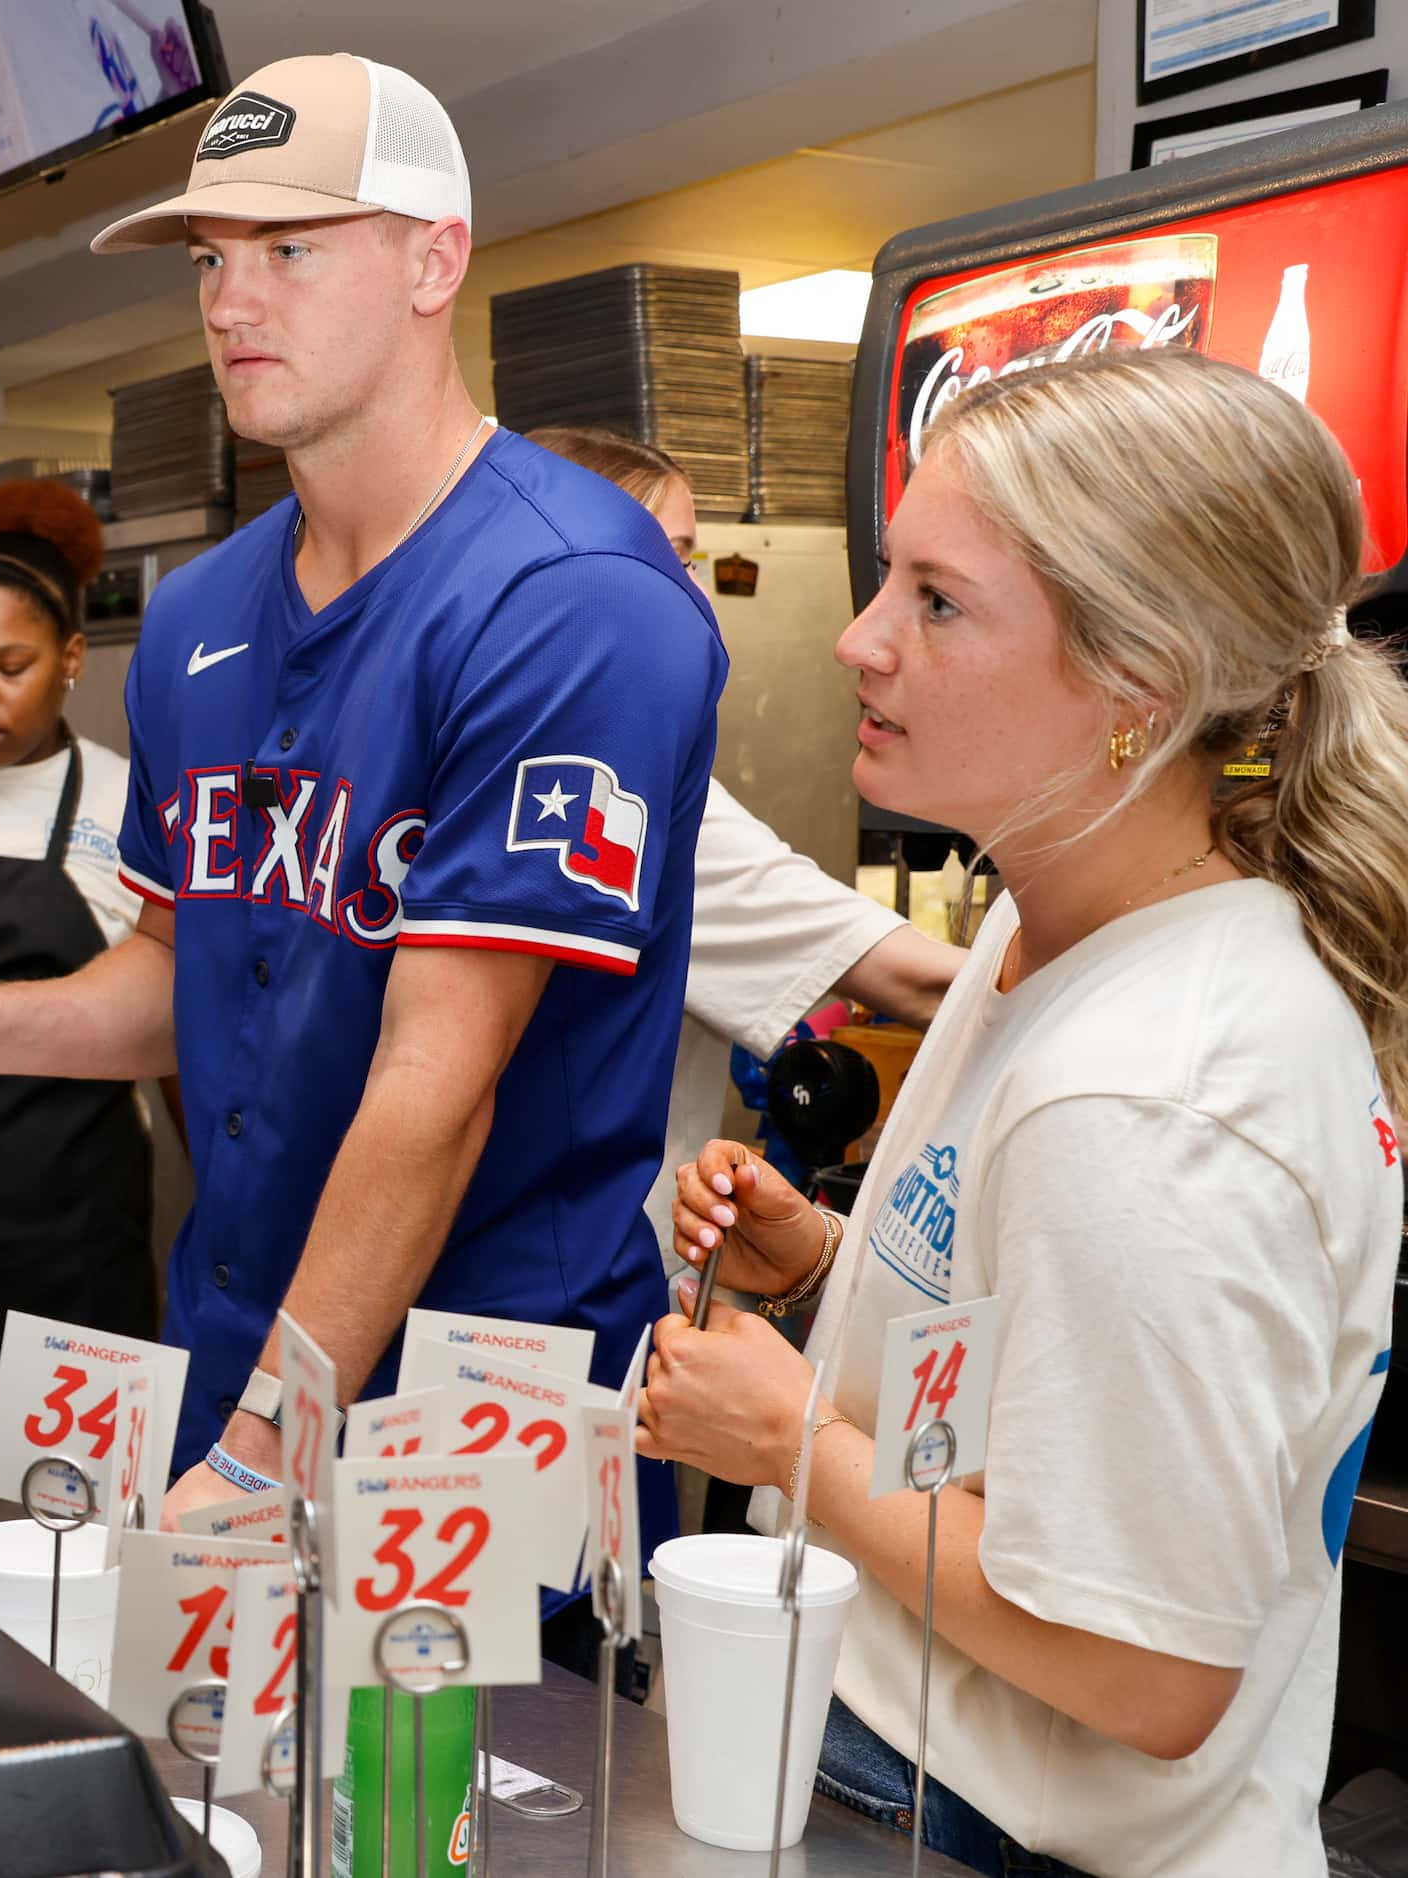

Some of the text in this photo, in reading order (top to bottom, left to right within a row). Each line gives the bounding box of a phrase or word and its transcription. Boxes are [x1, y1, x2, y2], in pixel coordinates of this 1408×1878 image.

[1224, 766, 1269, 776] LEMONADE
[157, 765, 428, 949] EXAS
[23, 1364, 118, 1461] 34
[903, 1339, 968, 1432] 14
[218, 1457, 238, 1477] THE
[237, 1471, 272, 1492] NDER
[354, 1505, 490, 1613] 32
[253, 1612, 298, 1715] 2
